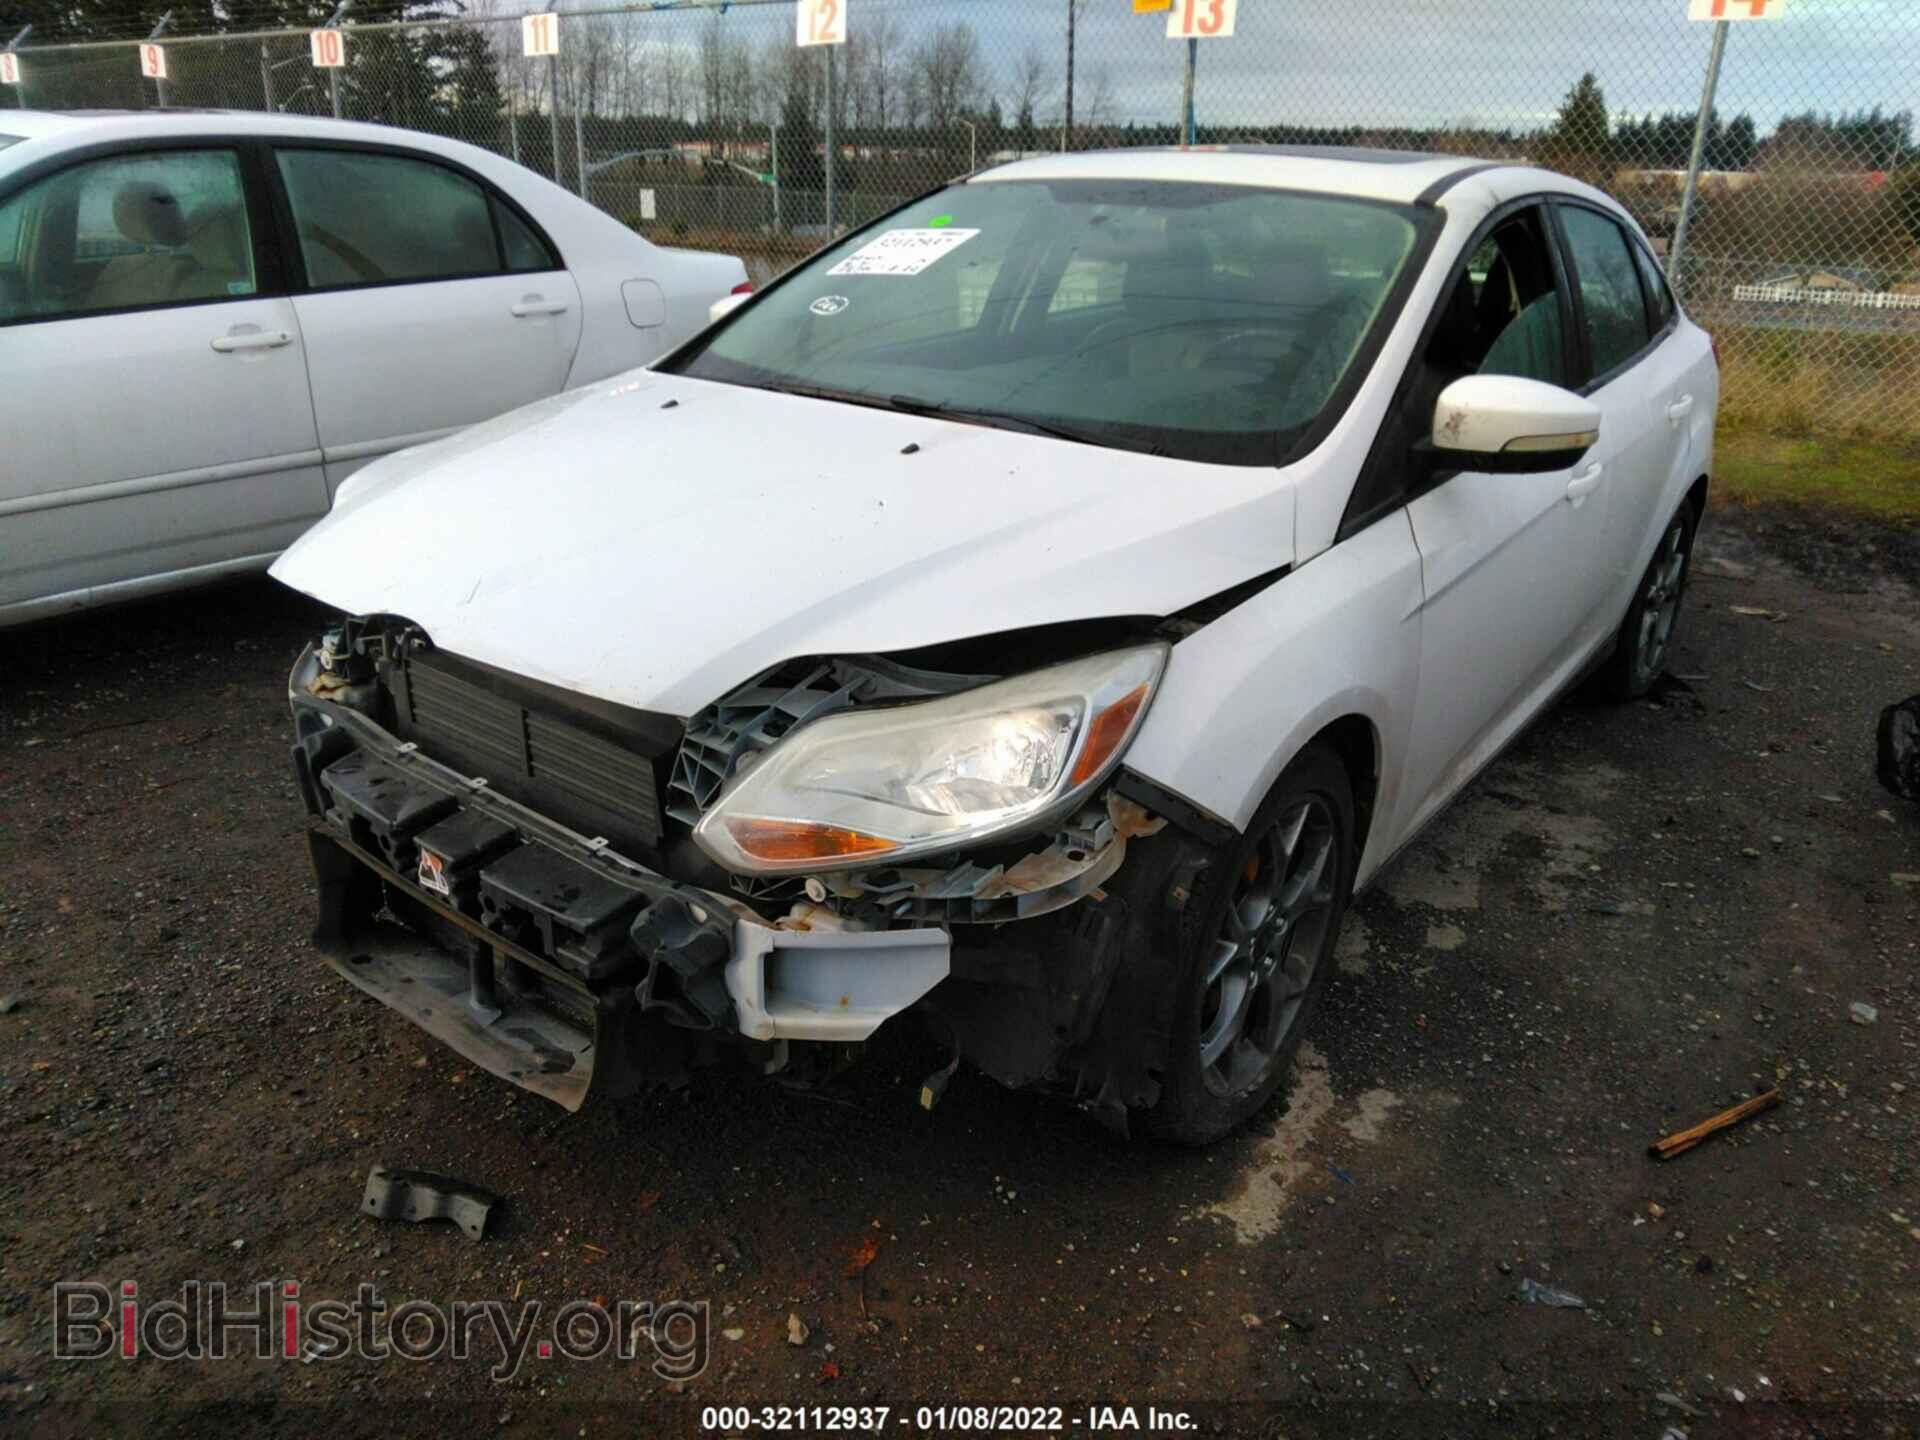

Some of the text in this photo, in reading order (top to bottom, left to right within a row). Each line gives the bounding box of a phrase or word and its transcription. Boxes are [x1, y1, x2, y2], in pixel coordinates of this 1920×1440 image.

[808, 0, 838, 40] 12
[1182, 0, 1224, 34] 13
[316, 32, 339, 64] 10
[530, 17, 550, 52] 11
[147, 46, 158, 74] 9
